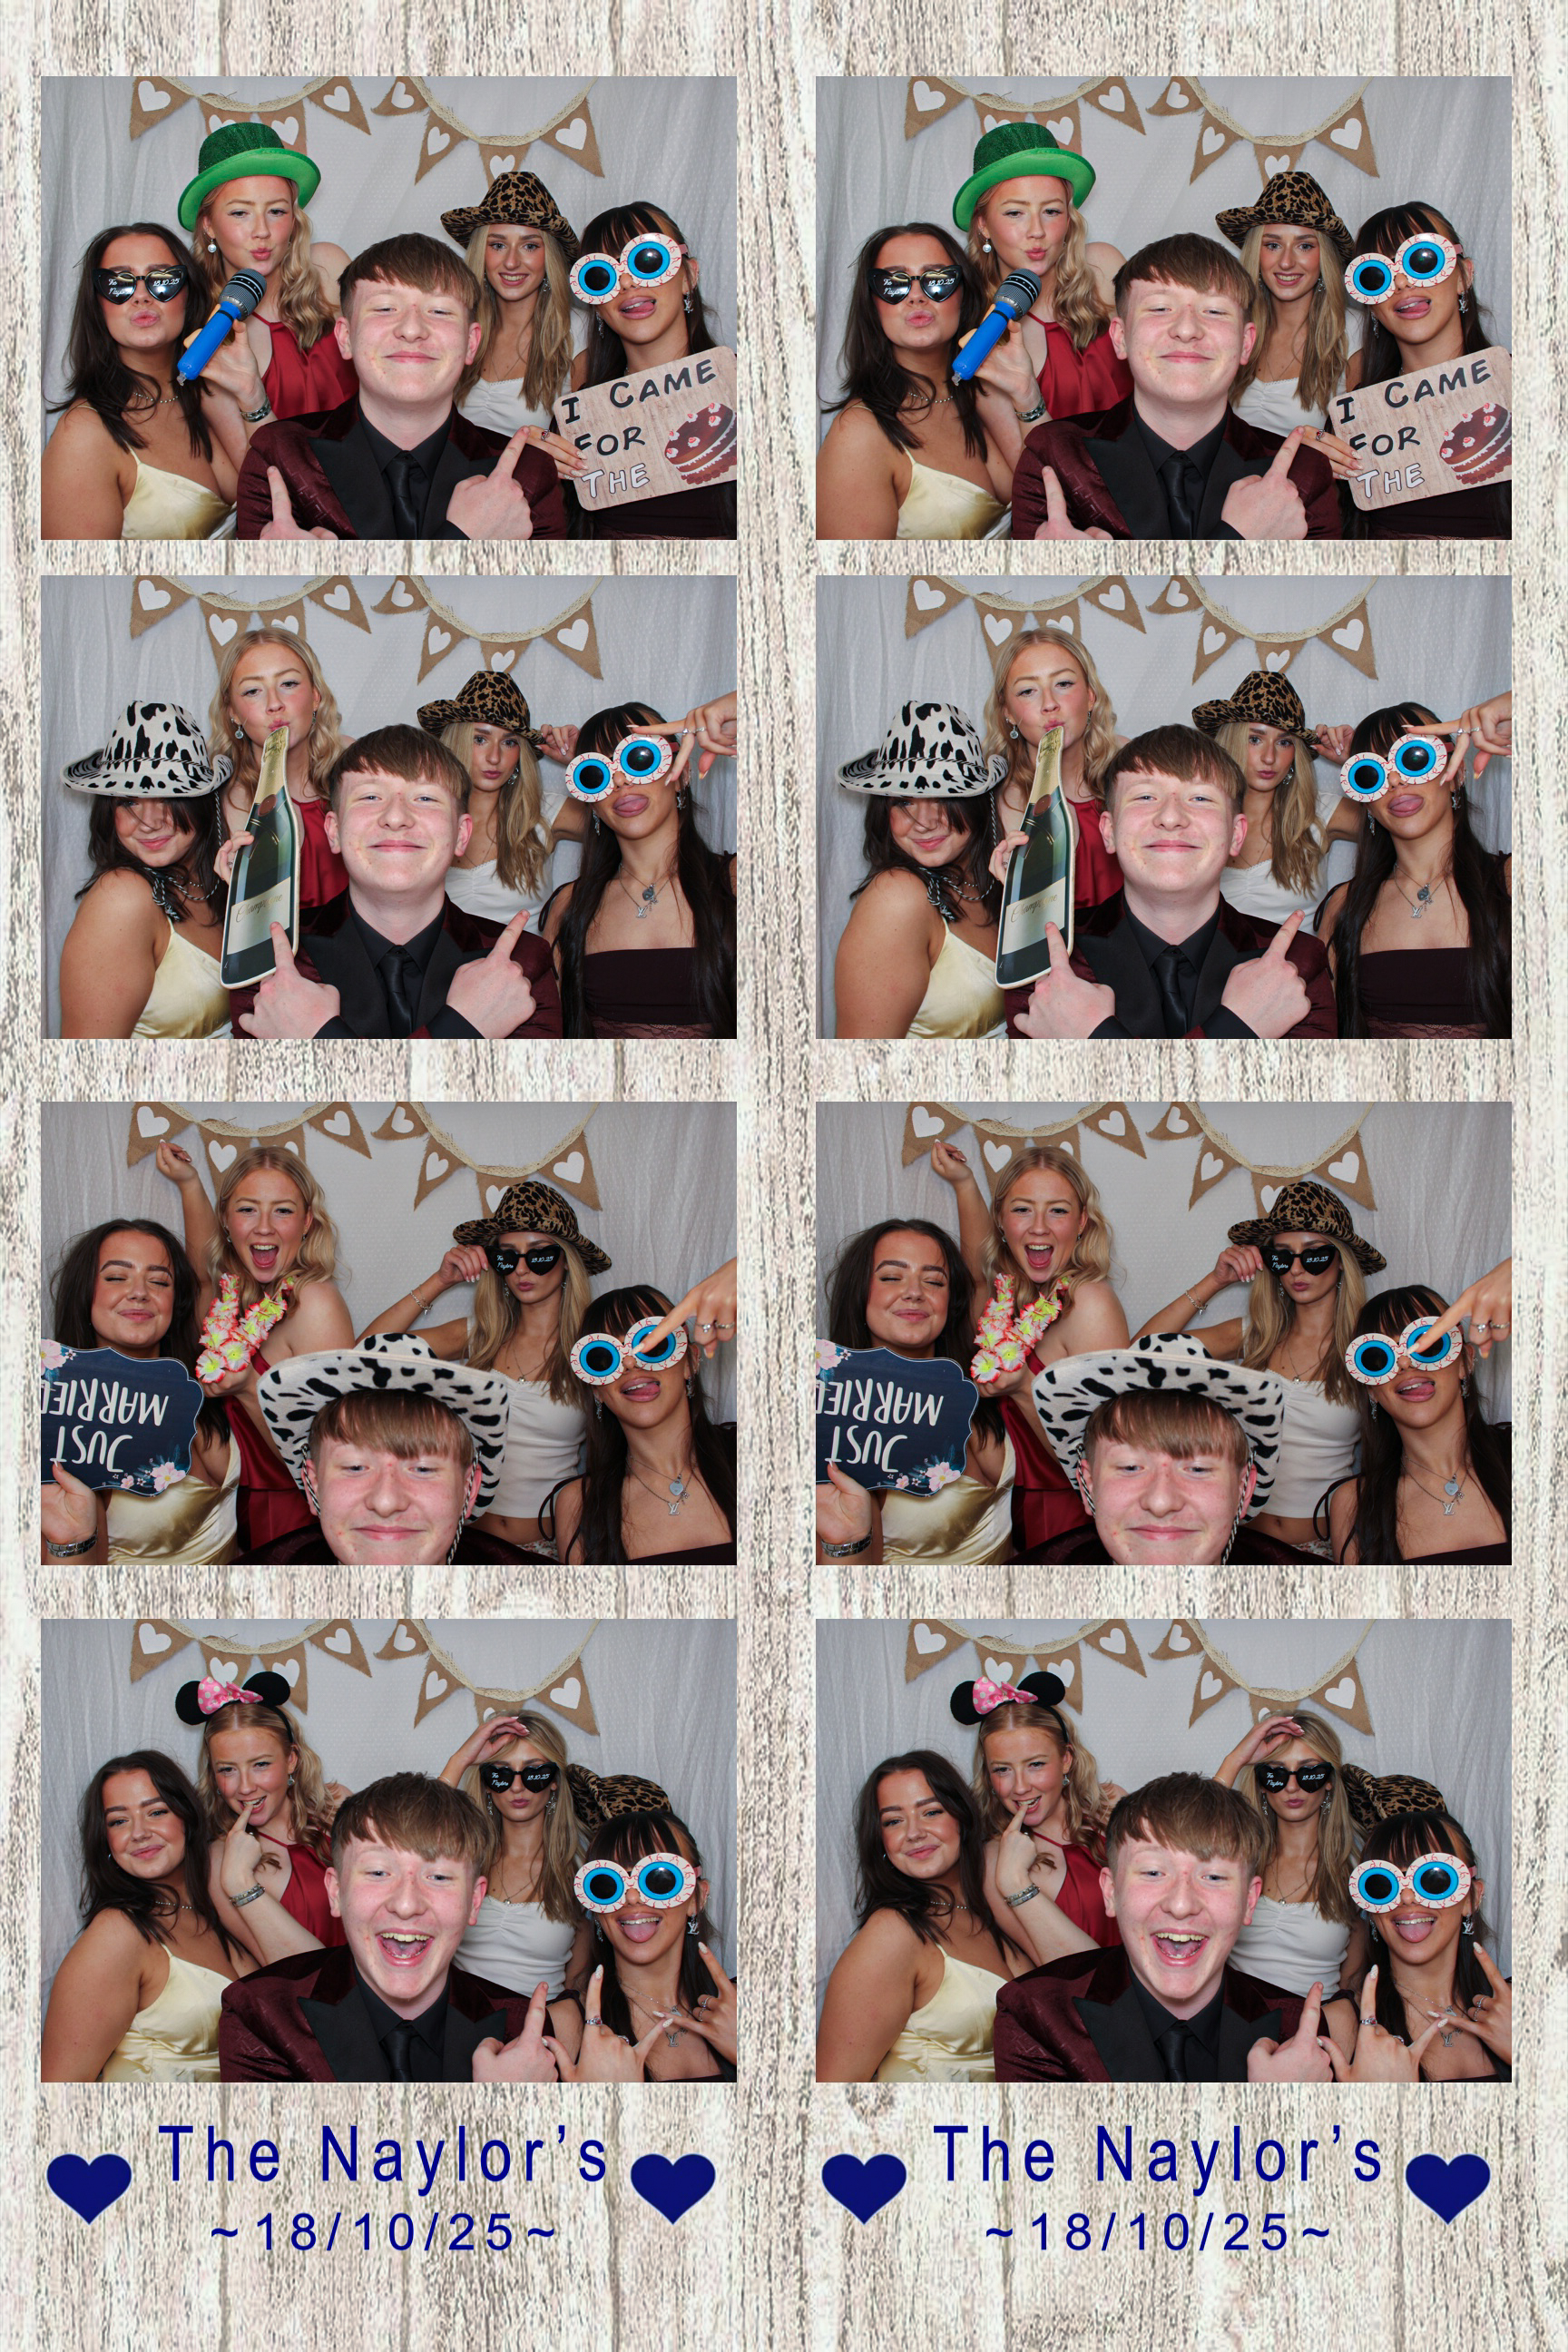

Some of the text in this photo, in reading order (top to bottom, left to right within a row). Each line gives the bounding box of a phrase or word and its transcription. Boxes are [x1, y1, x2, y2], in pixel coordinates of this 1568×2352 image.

[561, 358, 716, 424] I CAME
[1336, 358, 1491, 424] I CAME
[574, 426, 645, 456] FOR
[1349, 426, 1420, 456] FOR
[581, 463, 650, 498] THE
[1356, 463, 1425, 498] THE
[49, 1425, 133, 1473] JUST
[824, 1425, 908, 1473] JUST
